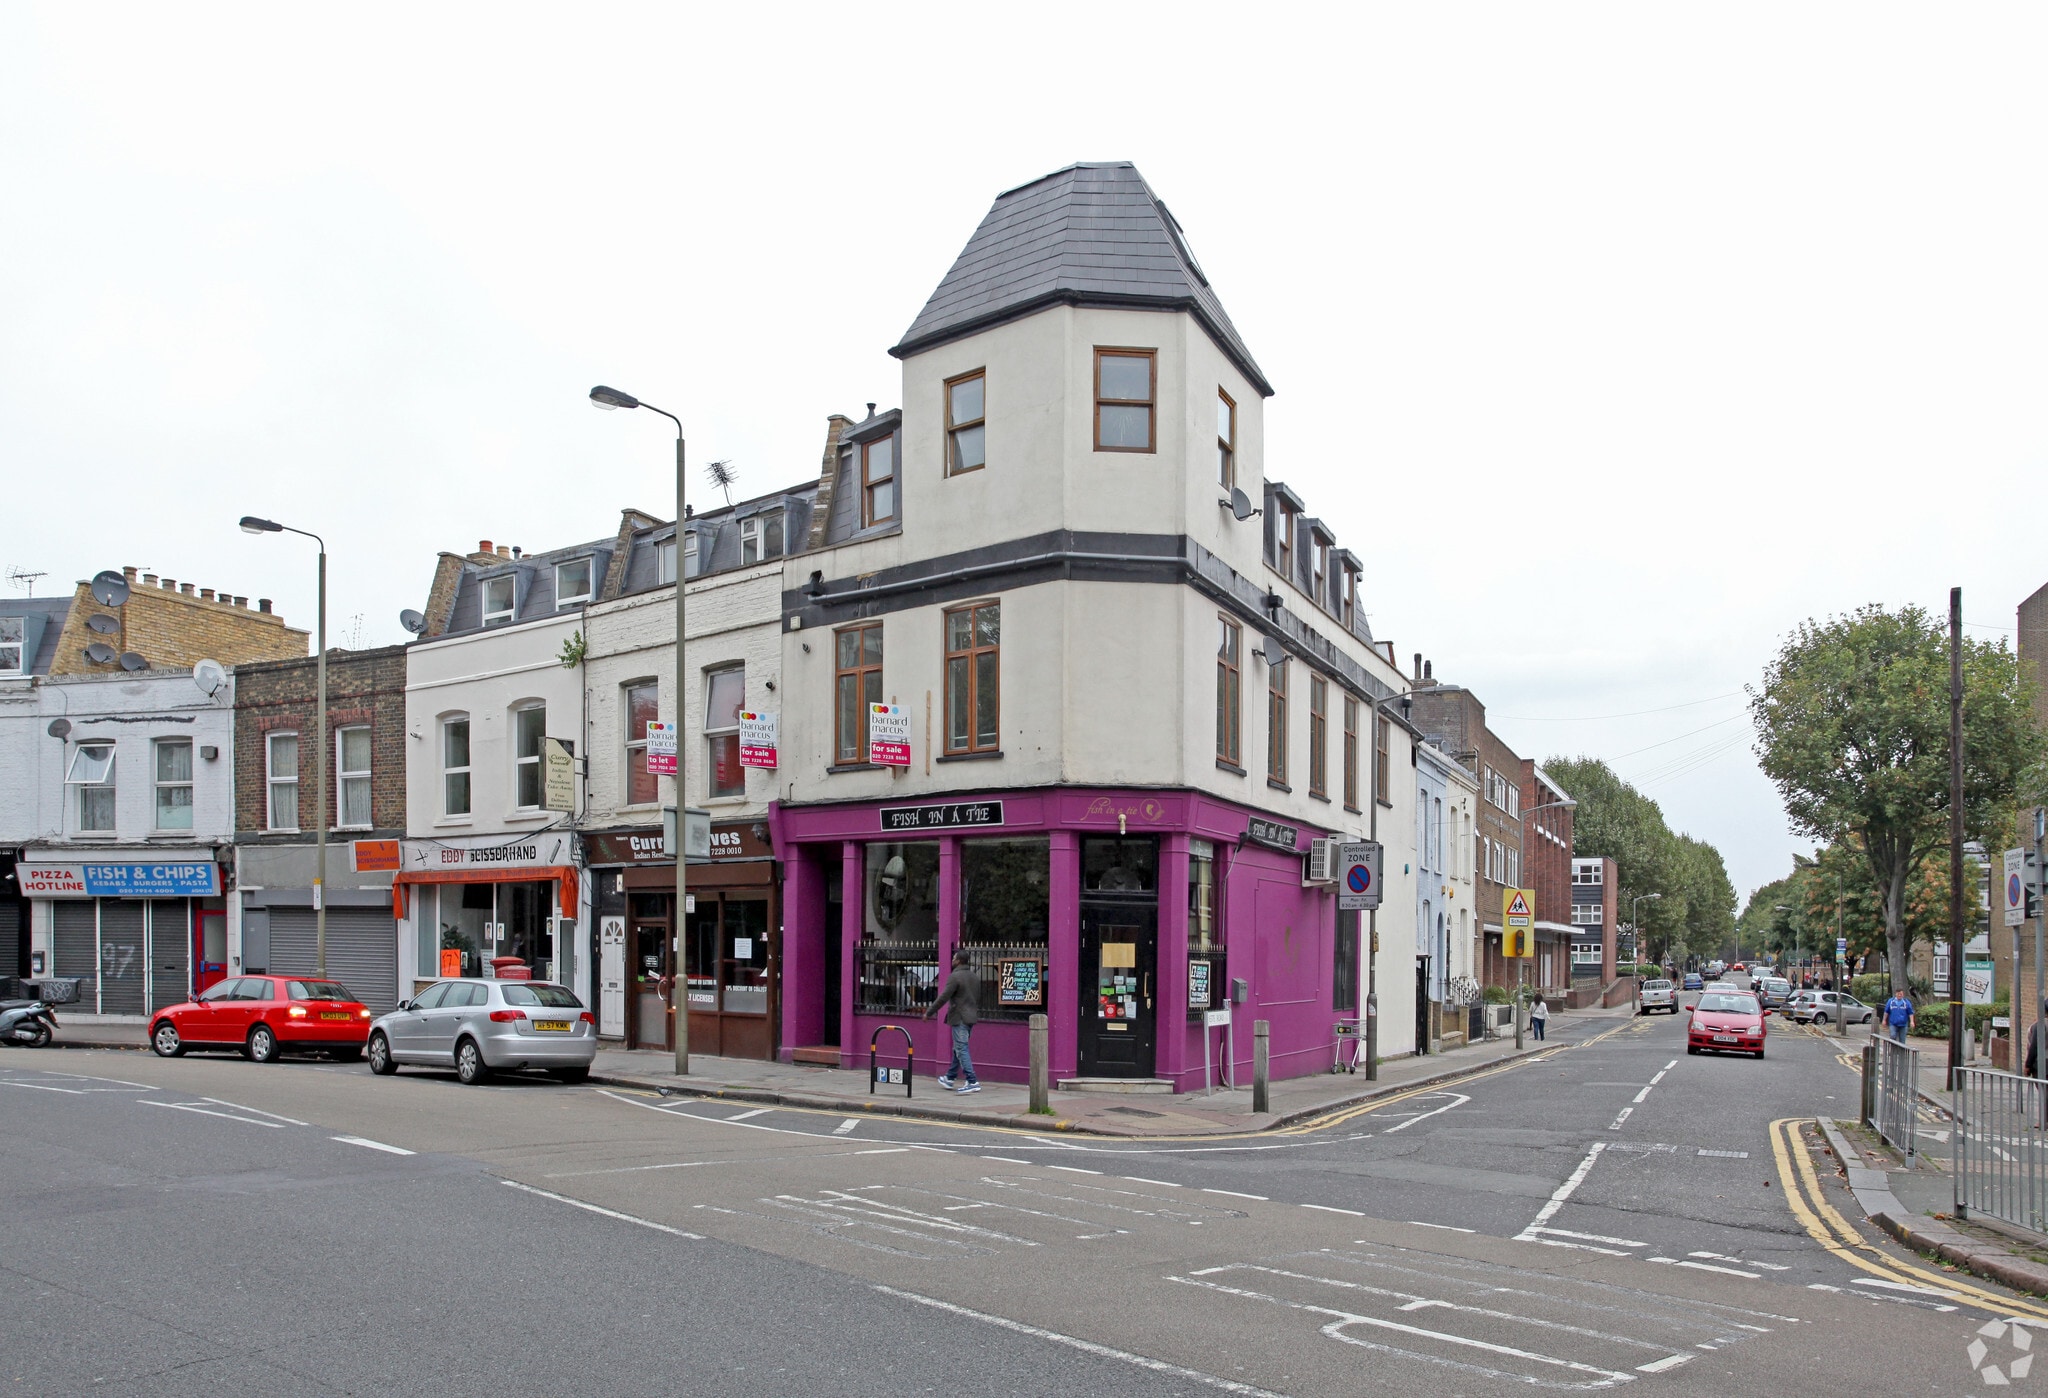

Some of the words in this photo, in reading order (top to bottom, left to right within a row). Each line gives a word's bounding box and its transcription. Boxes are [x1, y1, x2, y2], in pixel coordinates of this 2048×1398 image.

[872, 714, 908, 726] barnard
[741, 721, 774, 732] barnard
[872, 725, 904, 734] marcus
[648, 731, 677, 740] barnar
[741, 731, 770, 739] marcus
[872, 744, 884, 752] for
[658, 756, 668, 764] let
[1080, 797, 1111, 820] fish
[1106, 806, 1115, 814] in
[1126, 806, 1138, 814] tie
[892, 808, 921, 826] FISH
[928, 806, 946, 824] IN
[952, 805, 960, 822] A
[966, 806, 990, 822] TIE
[630, 836, 664, 850] Curr
[710, 832, 740, 846] ves
[441, 850, 465, 863] EDDY
[470, 845, 536, 862] SCISSORHAND
[1348, 854, 1370, 862] ZONE
[2006, 852, 2022, 861] Controlled
[2008, 861, 2020, 871] ZONE
[31, 870, 73, 879] PIZZA
[87, 866, 127, 879] FISH
[133, 866, 146, 879] &
[152, 866, 207, 879] CHIPS
[25, 882, 84, 890] HOTLINE
[693, 994, 714, 1003] LICENSED
[880, 1069, 886, 1080] P
